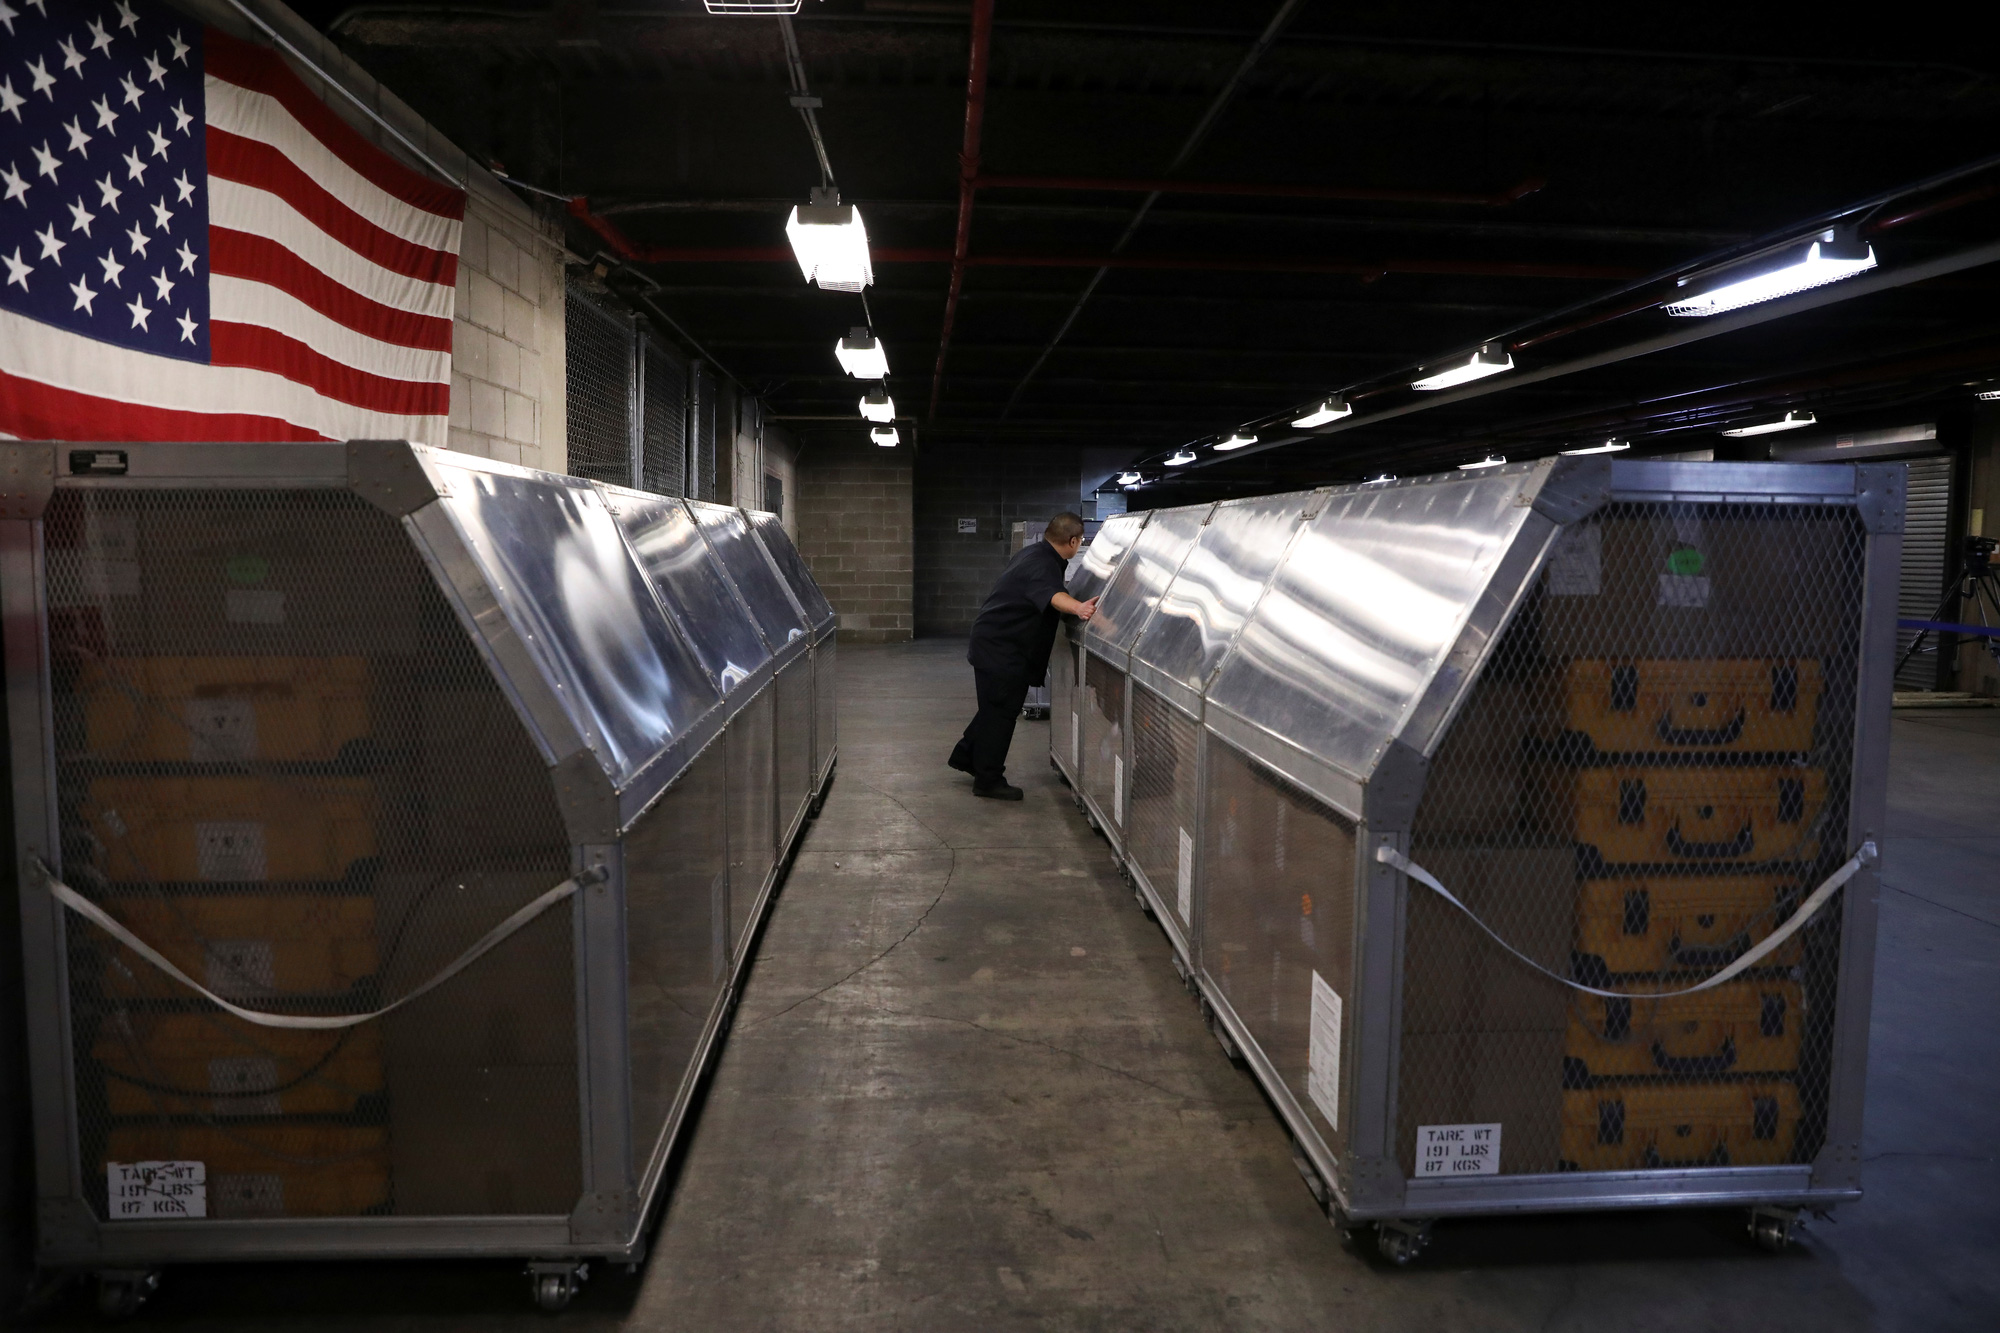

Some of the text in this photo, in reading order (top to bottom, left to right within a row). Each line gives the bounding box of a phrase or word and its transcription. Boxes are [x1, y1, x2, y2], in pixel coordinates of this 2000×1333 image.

[1428, 1129, 1492, 1141] TARE WT
[1427, 1144, 1489, 1157] 191 LBS
[1425, 1159, 1481, 1172] 87 KGS
[174, 1166, 195, 1179] WT
[121, 1183, 194, 1197] 191 LBS
[122, 1200, 186, 1213] 87 KGS
